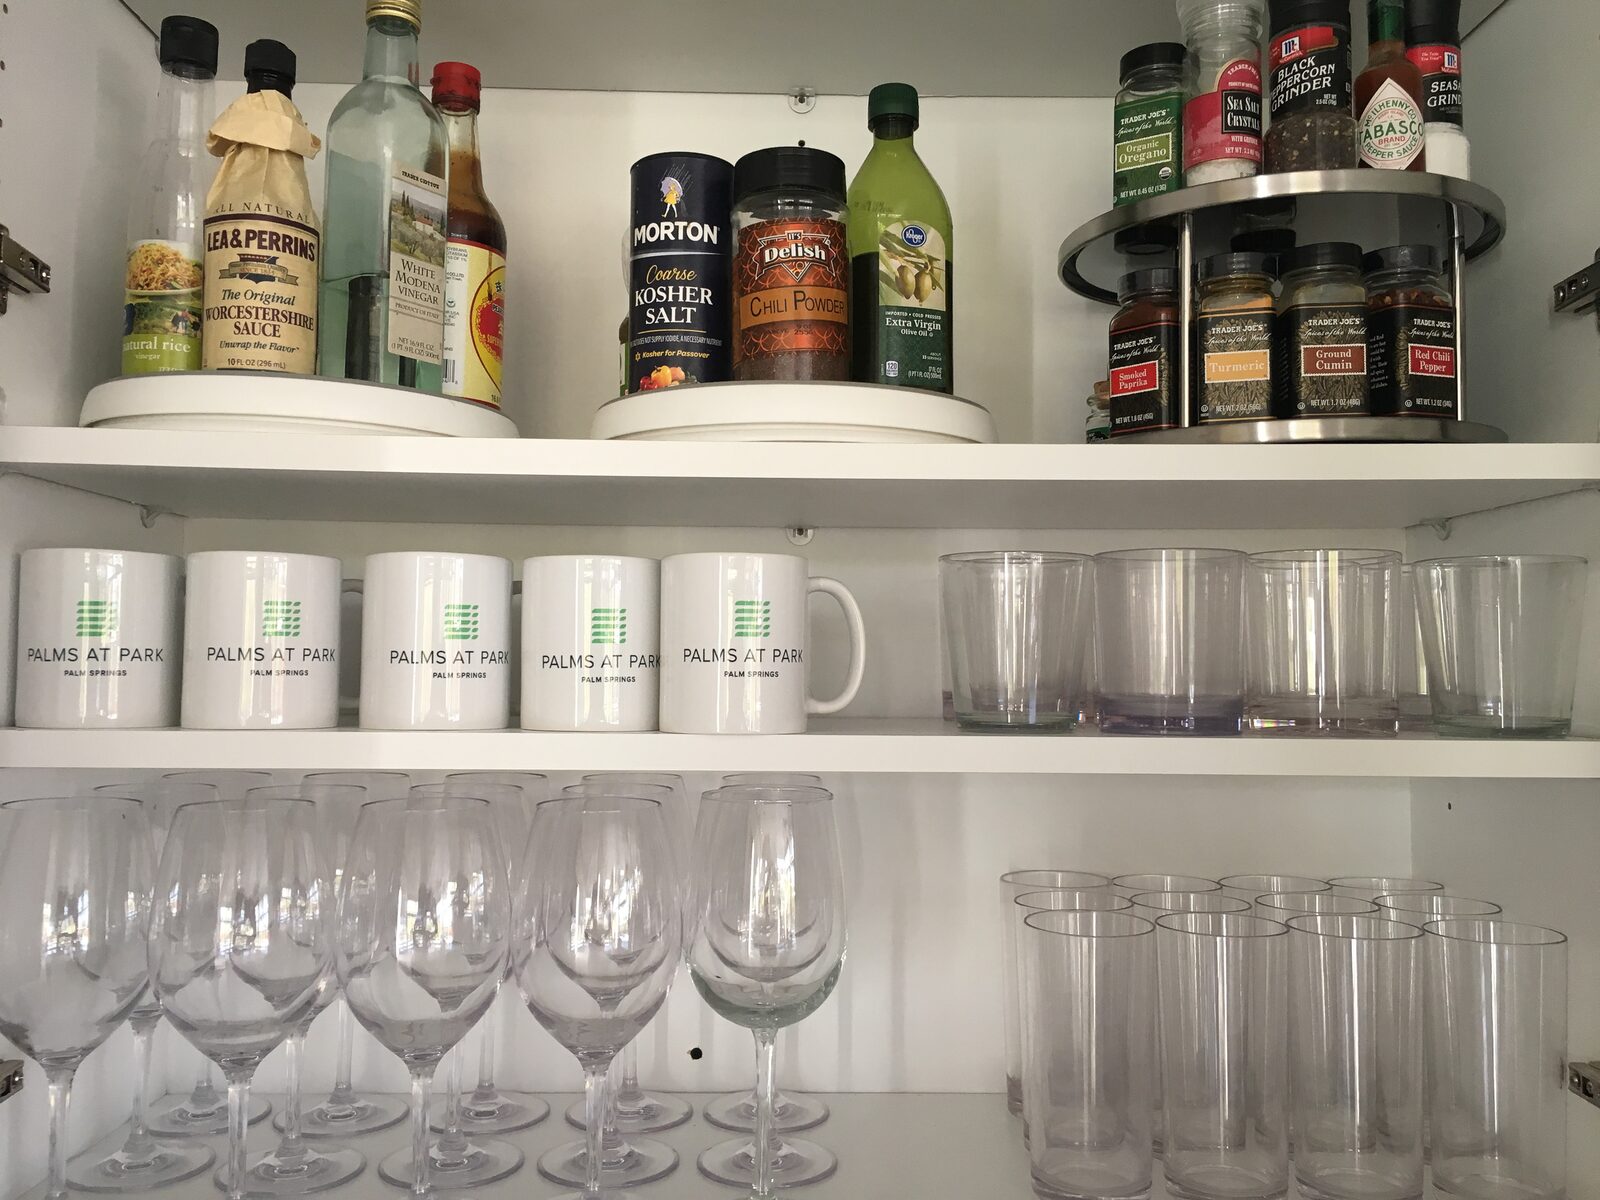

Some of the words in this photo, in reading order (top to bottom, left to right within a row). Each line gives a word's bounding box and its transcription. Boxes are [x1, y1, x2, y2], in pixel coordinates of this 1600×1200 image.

[1278, 55, 1316, 83] BLACK
[1270, 64, 1335, 100] EPPERCORN
[1271, 76, 1332, 112] GRINDER
[1227, 95, 1243, 111] SEA
[1245, 96, 1260, 116] SALT
[1120, 113, 1147, 126] TRADER
[1148, 109, 1167, 119] JOE'S
[1227, 112, 1260, 131] CRYSTALS
[1359, 120, 1424, 145] TABASCO
[1126, 140, 1160, 153] Organic
[1364, 142, 1394, 159] PEPPER
[1396, 135, 1419, 158] SAUCE
[1378, 136, 1406, 146] BRAND
[1119, 148, 1167, 165] Oregano
[401, 170, 420, 182] TRADER
[1120, 190, 1128, 198] NET
[1148, 185, 1155, 193] OZ
[242, 201, 311, 225] NATURAL
[634, 221, 718, 247] MORTON
[788, 232, 801, 240] IT'S
[905, 230, 924, 244] Kroger
[764, 242, 827, 264] Delish
[401, 258, 436, 280] WHITE
[646, 264, 698, 285] Coarse
[395, 270, 441, 294] MODENA
[221, 289, 241, 301] The
[243, 289, 296, 306] Original
[398, 285, 440, 306] VINEGAR
[635, 285, 714, 307] KOSHER
[395, 302, 418, 313] PRODUCT
[750, 296, 788, 318] CHILI
[793, 290, 845, 315] POWDER
[205, 305, 315, 332] WORCESTERSHIRE
[645, 306, 697, 326] SALT
[233, 320, 281, 338] SAUCE
[885, 317, 912, 328] Extra
[914, 320, 942, 332] Virgin
[1212, 326, 1241, 334] TRADER
[1242, 324, 1264, 332] JOE'S
[1414, 318, 1436, 327] TRADER
[1436, 320, 1452, 329] JOE'S
[900, 328, 918, 336] Olive
[1347, 326, 1368, 336] World
[162, 338, 191, 352] rice
[220, 340, 252, 351] Unwrap
[252, 341, 268, 350] the
[652, 335, 665, 343] SUPPLY
[1114, 340, 1136, 350] TRADER
[1136, 336, 1154, 346] JOE'S
[642, 350, 664, 358] Kosher
[664, 349, 676, 357] for
[676, 350, 710, 358] Passover
[1316, 348, 1352, 358] Ground
[1415, 349, 1430, 360] Red
[1432, 350, 1451, 362] Chili
[227, 358, 236, 366] 10
[236, 358, 246, 366] FL
[246, 359, 256, 367] OZ
[256, 359, 272, 368] (296
[1209, 360, 1265, 373] Turmeric
[1316, 360, 1352, 370] Cumin
[1420, 360, 1446, 373] Pepper
[1119, 368, 1147, 382] Smoked
[1119, 378, 1148, 390] Paprika
[1339, 398, 1346, 406] OZ
[27, 648, 78, 662] PALMS
[86, 648, 110, 662] AT
[120, 648, 164, 662] PARK
[207, 647, 265, 662] PALMS
[272, 648, 296, 662] AT
[302, 648, 336, 662] PARK
[390, 650, 446, 665] PALMS
[452, 650, 474, 664] AT
[480, 650, 510, 664] PARK
[542, 654, 594, 669] PALMS
[600, 654, 623, 668] AT
[630, 654, 660, 668] PARK
[683, 648, 738, 663] PALMS
[744, 648, 766, 662] AT
[772, 649, 804, 663] PARK
[581, 676, 602, 684] PALM
[604, 676, 636, 684] SPRINGS
